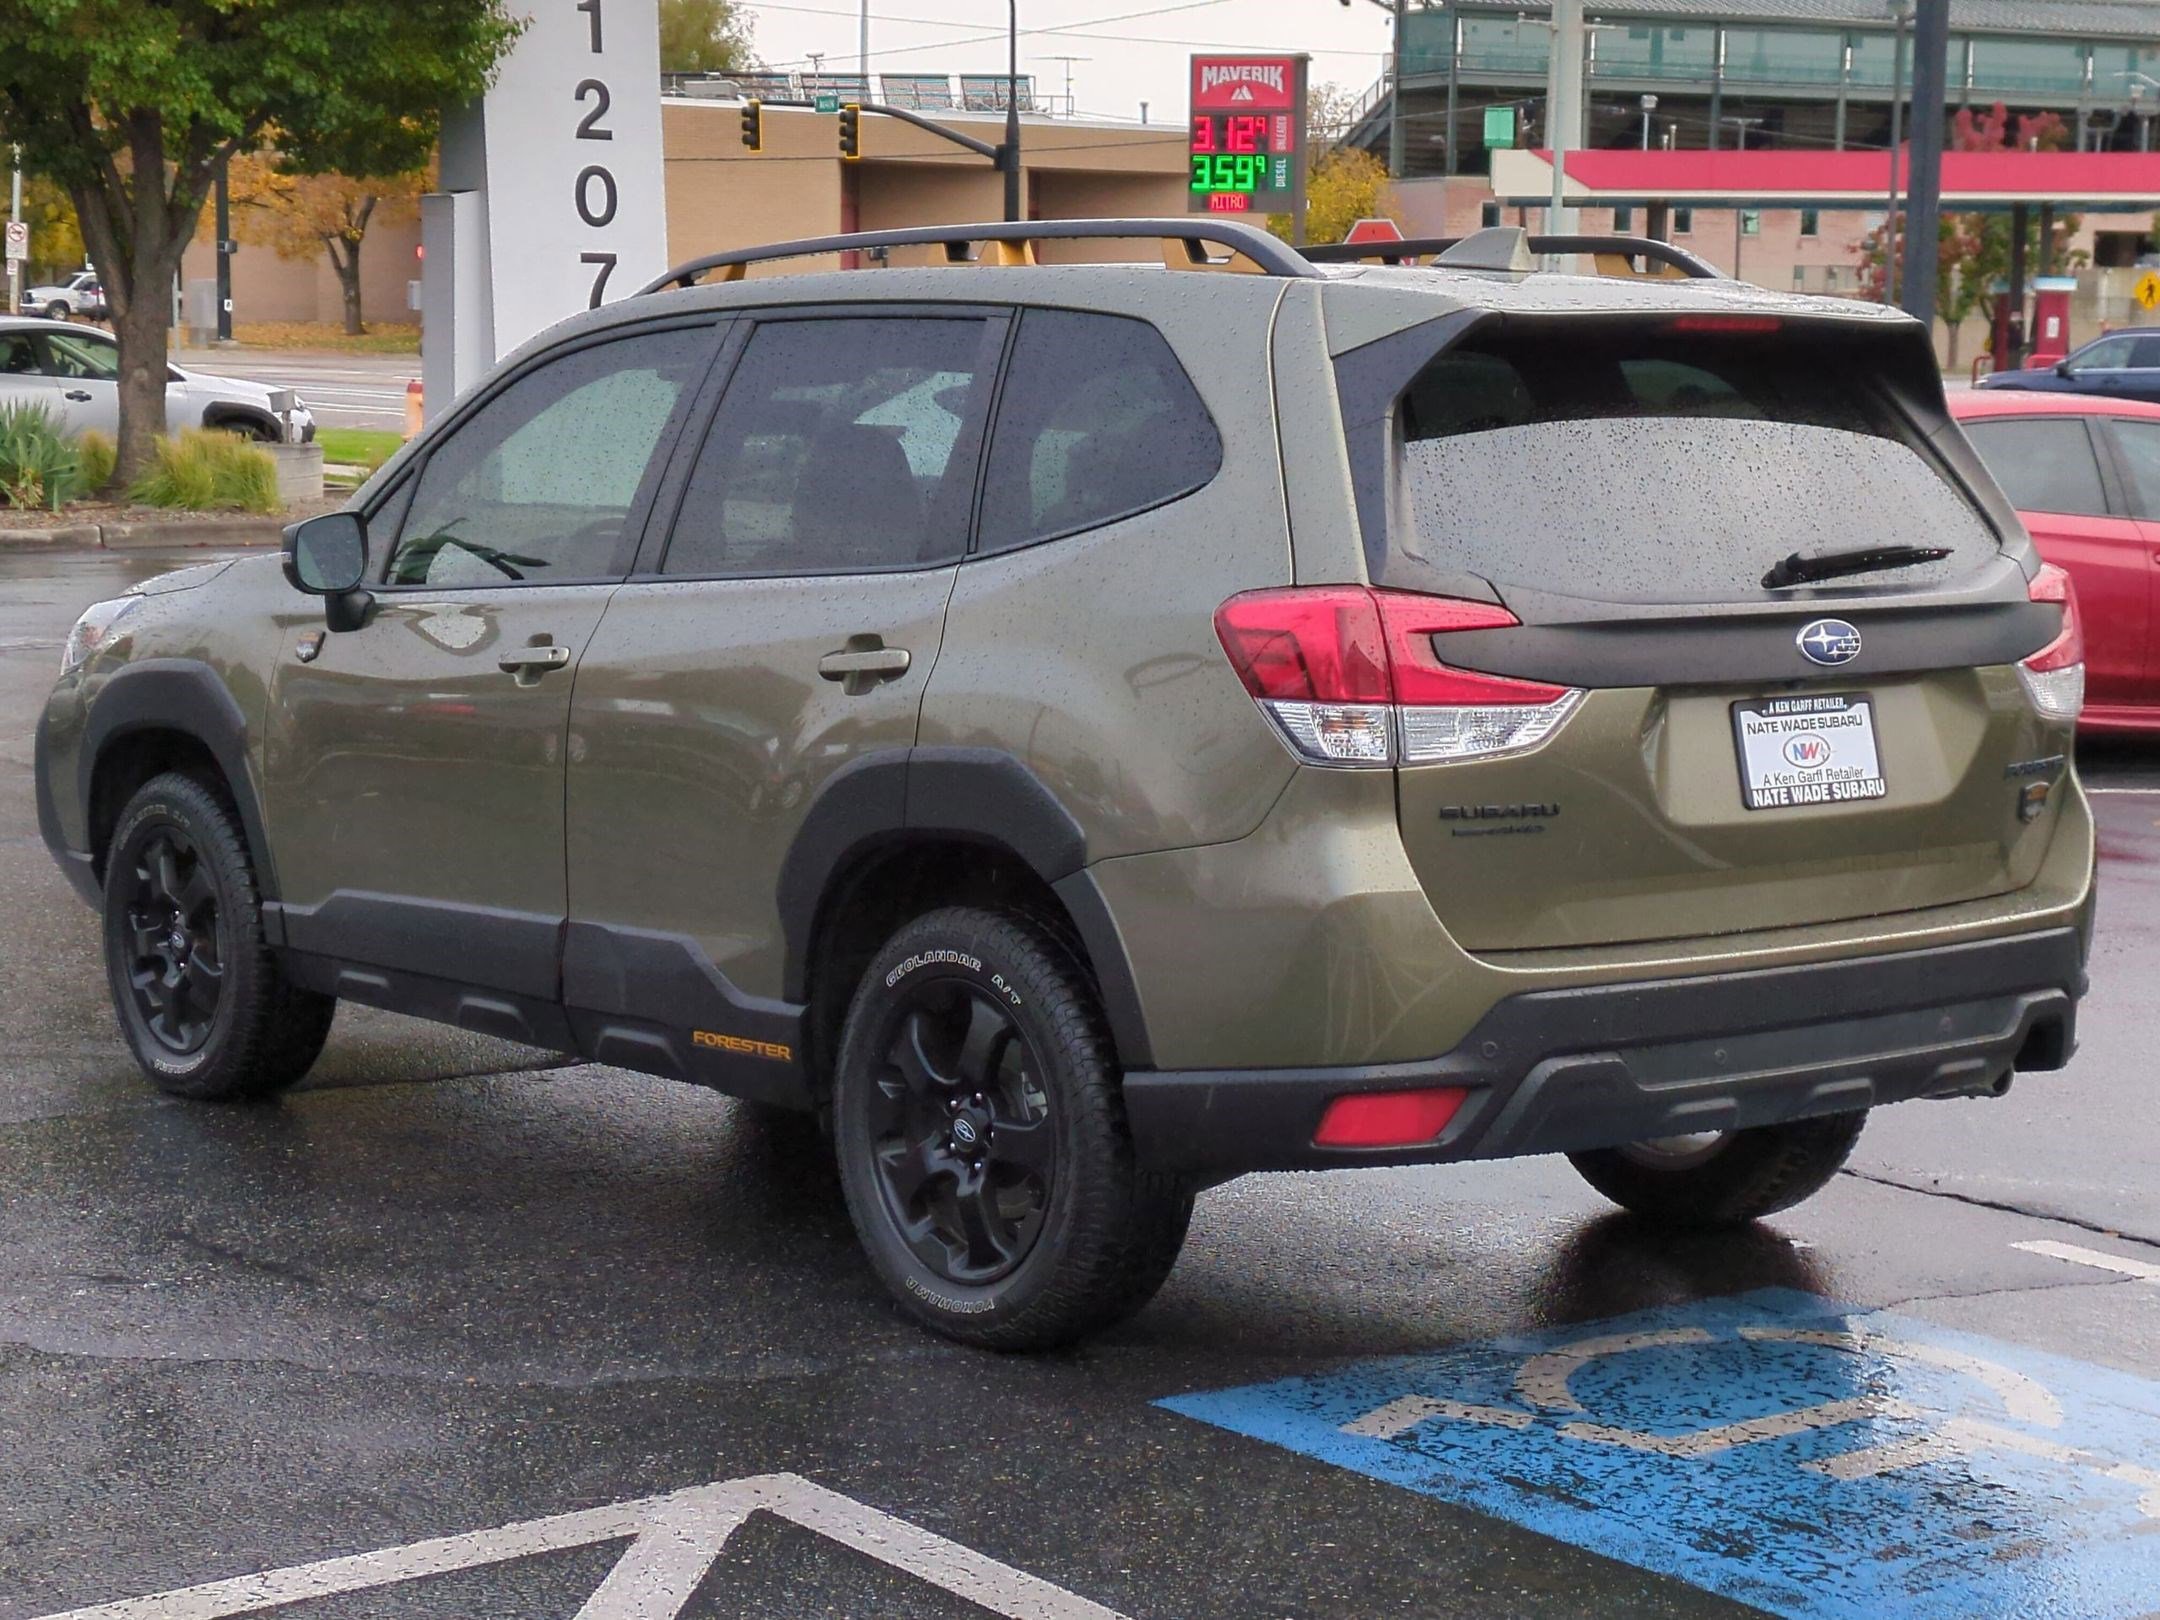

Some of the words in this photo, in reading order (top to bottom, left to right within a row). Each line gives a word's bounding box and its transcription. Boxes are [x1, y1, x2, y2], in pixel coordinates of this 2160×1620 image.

[1201, 65, 1284, 93] MAVERIK
[1275, 158, 1286, 188] DIESEL
[1211, 194, 1244, 209] NITRO
[1768, 702, 1775, 714] A
[1775, 700, 1790, 713] KEN
[1791, 699, 1812, 712] GARFF
[1813, 697, 1844, 710] RETAILER
[1747, 721, 1779, 735] NATE
[1780, 717, 1817, 732] WADE
[1818, 714, 1863, 729] SUBARU
[1763, 774, 1772, 787] A
[1774, 772, 1795, 785] Ken
[1797, 769, 1823, 783] Garff
[1826, 766, 1864, 781] Retailer
[1753, 788, 1789, 808] NATE
[1790, 784, 1831, 803] WADE
[1832, 778, 1886, 799] SUBARU
[1439, 803, 1560, 819] SUBARU
[885, 950, 982, 987] GEOLANDAR
[692, 1030, 792, 1060] FORESTER
